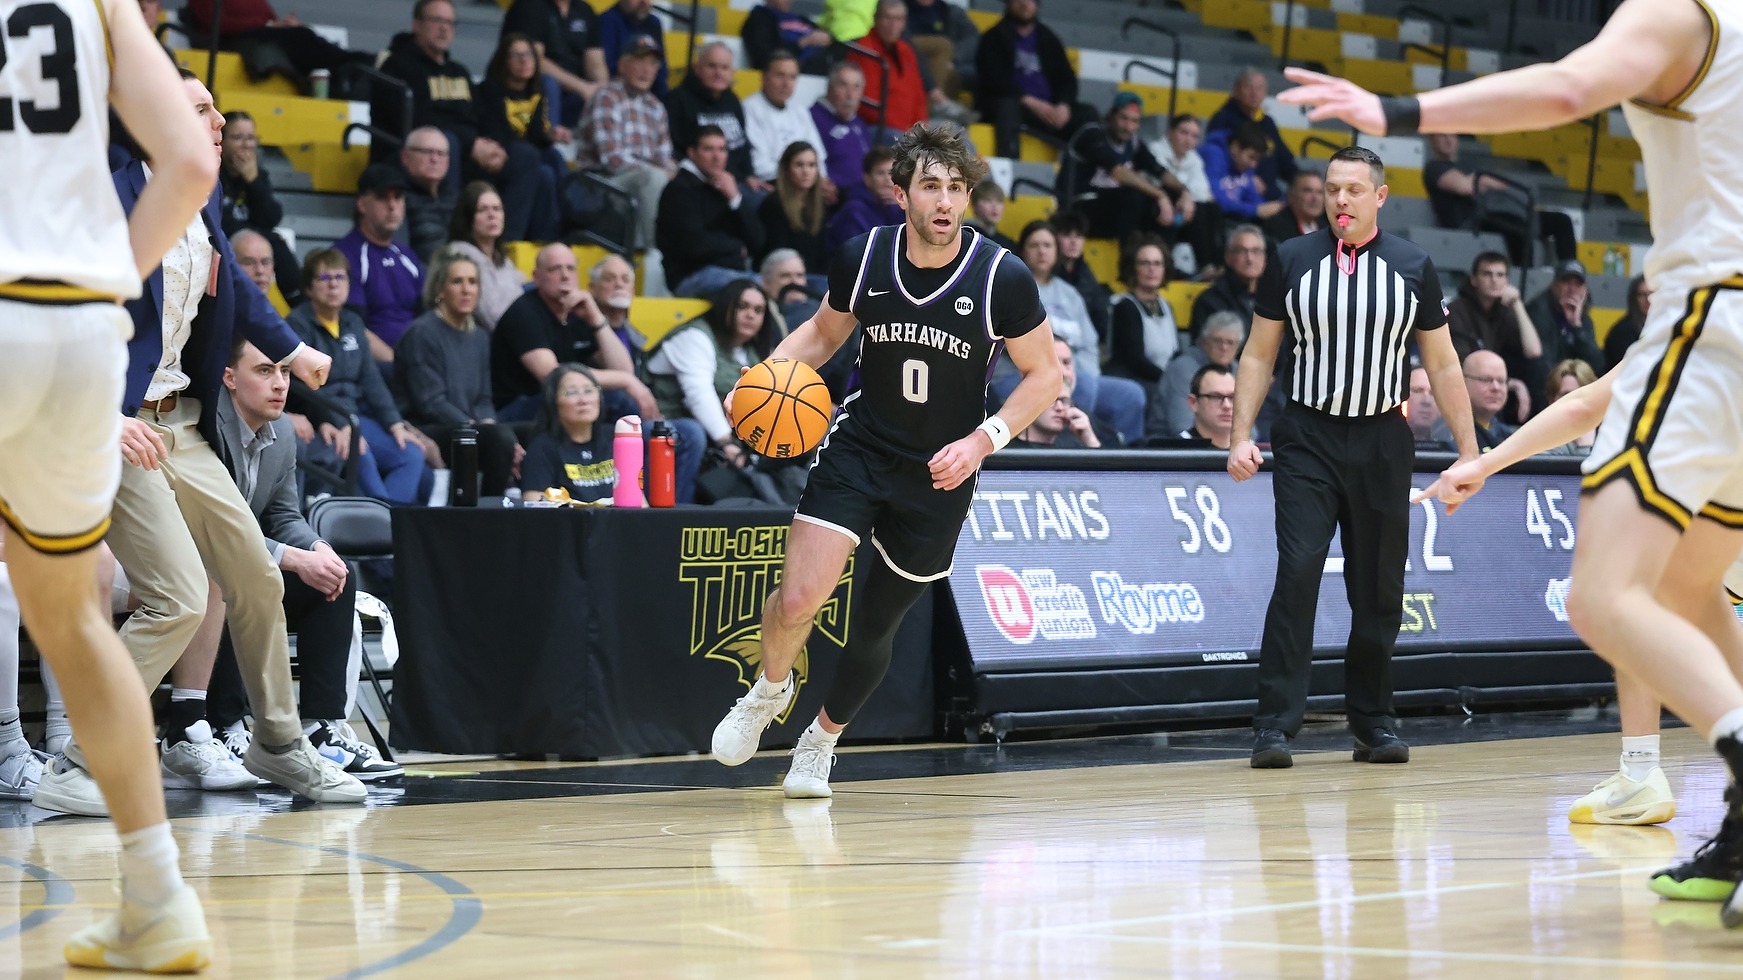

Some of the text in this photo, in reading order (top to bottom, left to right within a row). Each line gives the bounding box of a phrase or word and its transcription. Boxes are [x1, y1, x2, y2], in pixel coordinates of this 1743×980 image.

[902, 359, 929, 404] 0
[1165, 485, 1232, 554] 58
[1526, 489, 1576, 550] 45
[1033, 590, 1083, 612] credit
[1039, 618, 1091, 635] union
[1093, 574, 1203, 631] Rhyme
